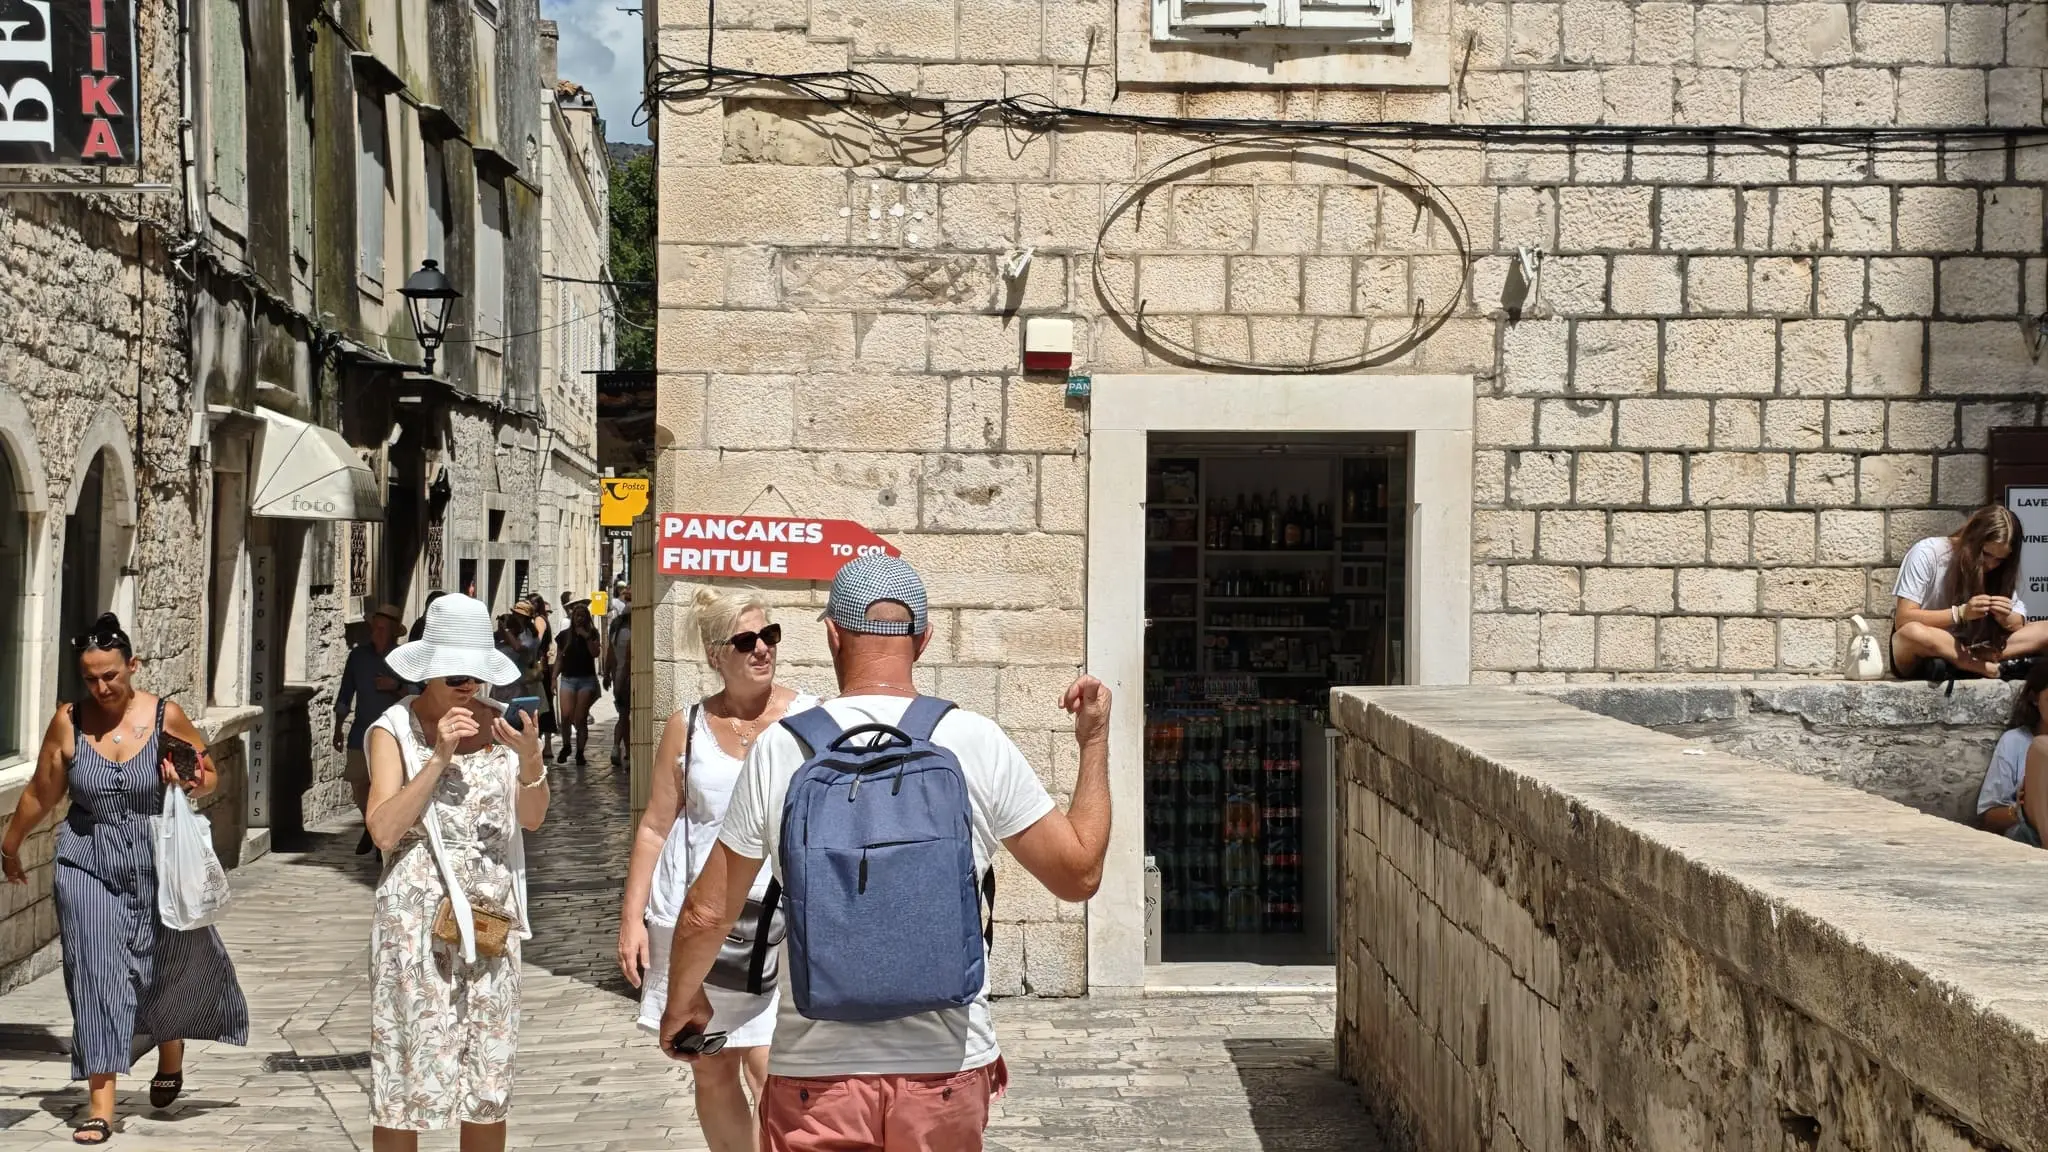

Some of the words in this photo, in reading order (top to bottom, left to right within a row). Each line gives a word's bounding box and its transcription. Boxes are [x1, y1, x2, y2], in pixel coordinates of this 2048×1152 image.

[622, 482, 646, 491] Pošta
[291, 494, 336, 513] foto
[664, 517, 823, 544] PANCAKES
[663, 547, 788, 574] FRITULE
[830, 543, 853, 556] TO
[857, 544, 886, 557] GO!
[256, 556, 268, 619] Foto
[2030, 582, 2048, 592] GI
[252, 672, 264, 817] Sovenirs
